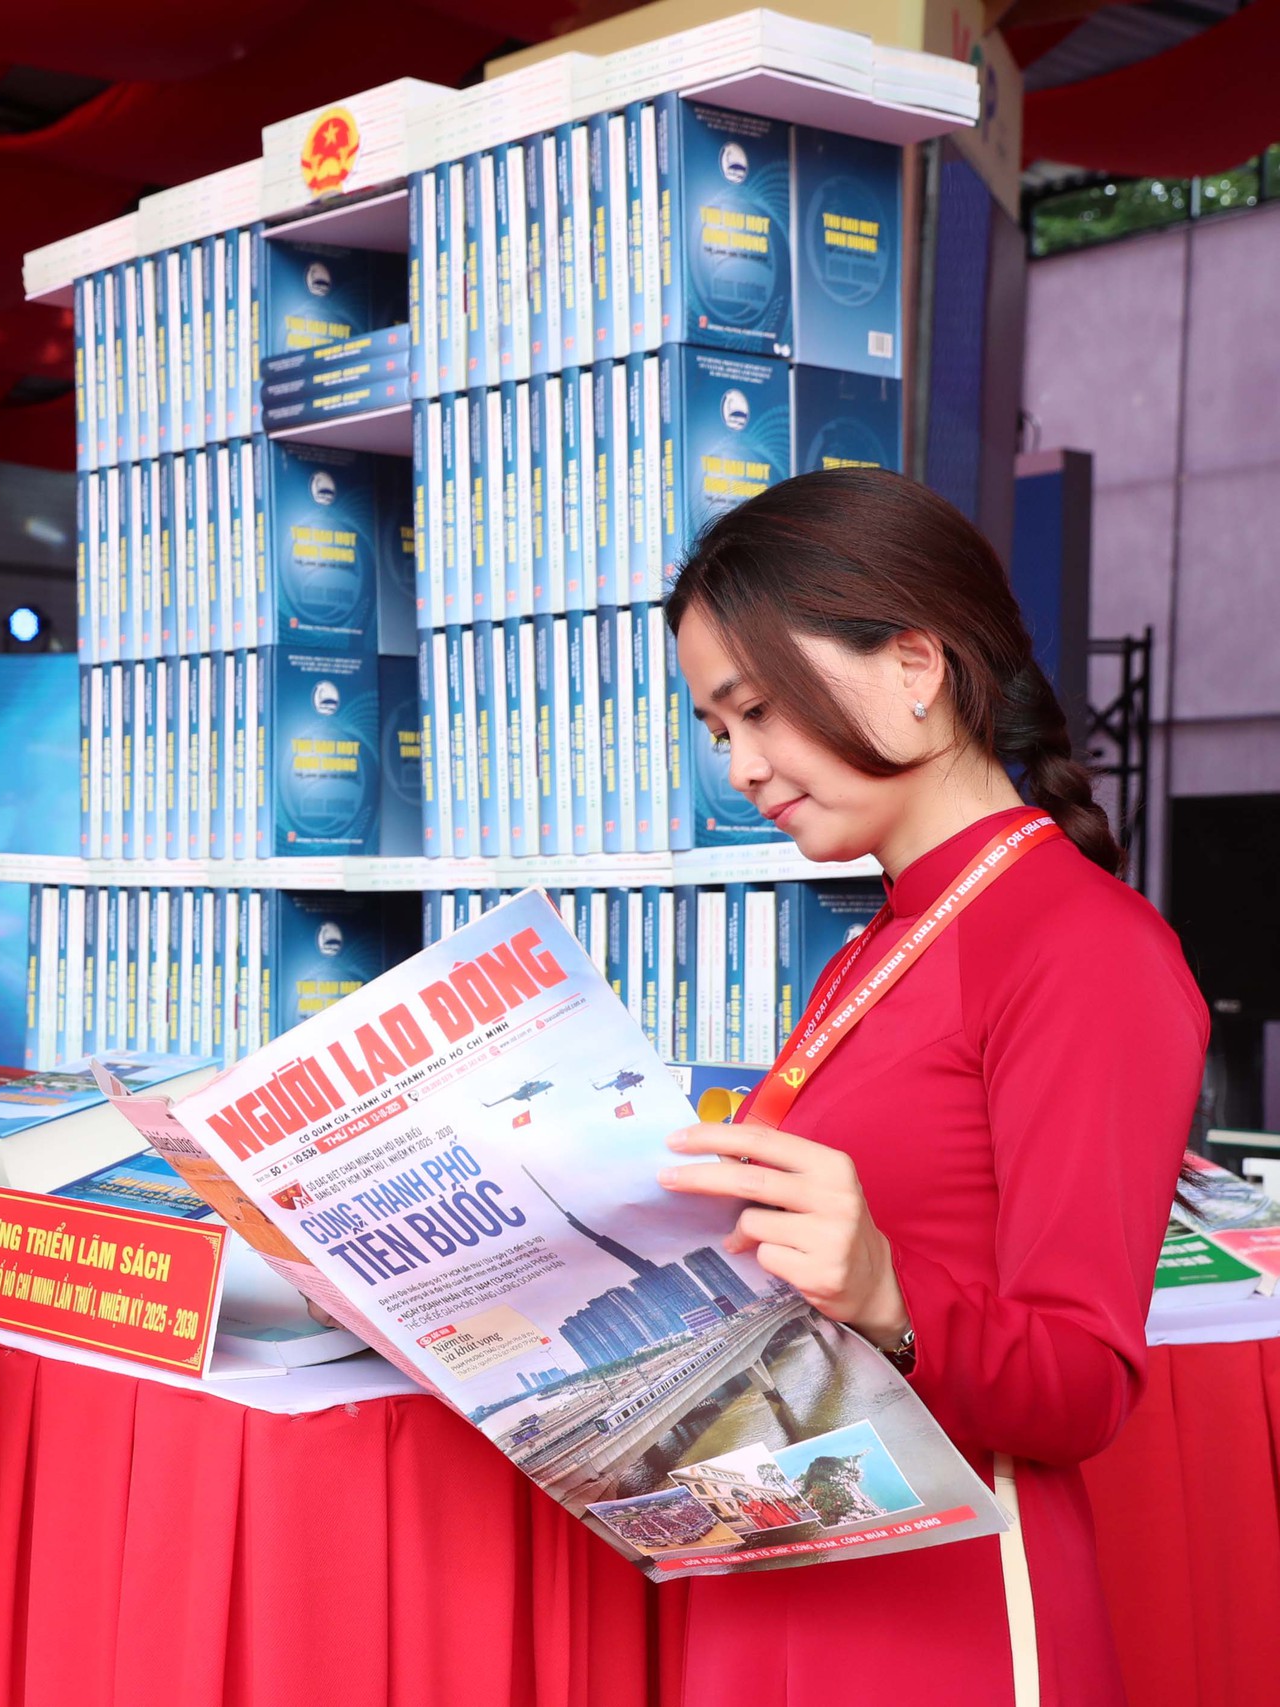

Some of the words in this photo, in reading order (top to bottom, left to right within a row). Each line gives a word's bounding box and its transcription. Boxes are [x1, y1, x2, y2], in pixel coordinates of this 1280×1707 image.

[1005, 831, 1023, 849] HỒ
[984, 845, 1008, 868] CHÍ
[956, 864, 989, 896] MINH
[911, 917, 937, 943] THỨ
[868, 951, 906, 991] NHIỆM
[853, 987, 874, 1007] KỲ
[831, 1004, 856, 1030] 2025
[205, 1056, 346, 1161] NGƯỜI
[327, 1002, 434, 1098] LAO
[418, 926, 569, 1043] ĐỘNG
[805, 1032, 829, 1059] 2030
[270, 1166, 282, 1177] 50
[293, 1147, 318, 1164] 10.536
[323, 1128, 349, 1147] THỨ
[347, 1118, 370, 1134] HAI
[370, 1101, 402, 1122] 13-10-2025
[299, 1201, 361, 1245] CÙNG
[351, 1168, 435, 1219] THÀNH
[420, 1134, 483, 1192] PHỐ
[327, 1219, 431, 1286] TIẾN
[403, 1180, 527, 1258] BƯỚC
[27, 1221, 73, 1263] TRIỂN
[77, 1233, 117, 1271] LÃM
[120, 1242, 172, 1283] SÁCH
[5, 1262, 18, 1296] HỒ
[15, 1269, 33, 1301] CHÍ
[31, 1274, 54, 1306] MINH
[53, 1272, 74, 1314] LẦN
[73, 1283, 94, 1317] THỨ
[97, 1289, 131, 1329] NHIỆM
[128, 1293, 145, 1328] KỲ
[144, 1301, 168, 1333] 2025
[172, 1308, 199, 1341] 2030
[432, 1339, 461, 1356] Niềm
[460, 1332, 474, 1345] tin
[442, 1351, 456, 1364] và
[455, 1342, 479, 1359] khát
[477, 1332, 504, 1347] vọng
